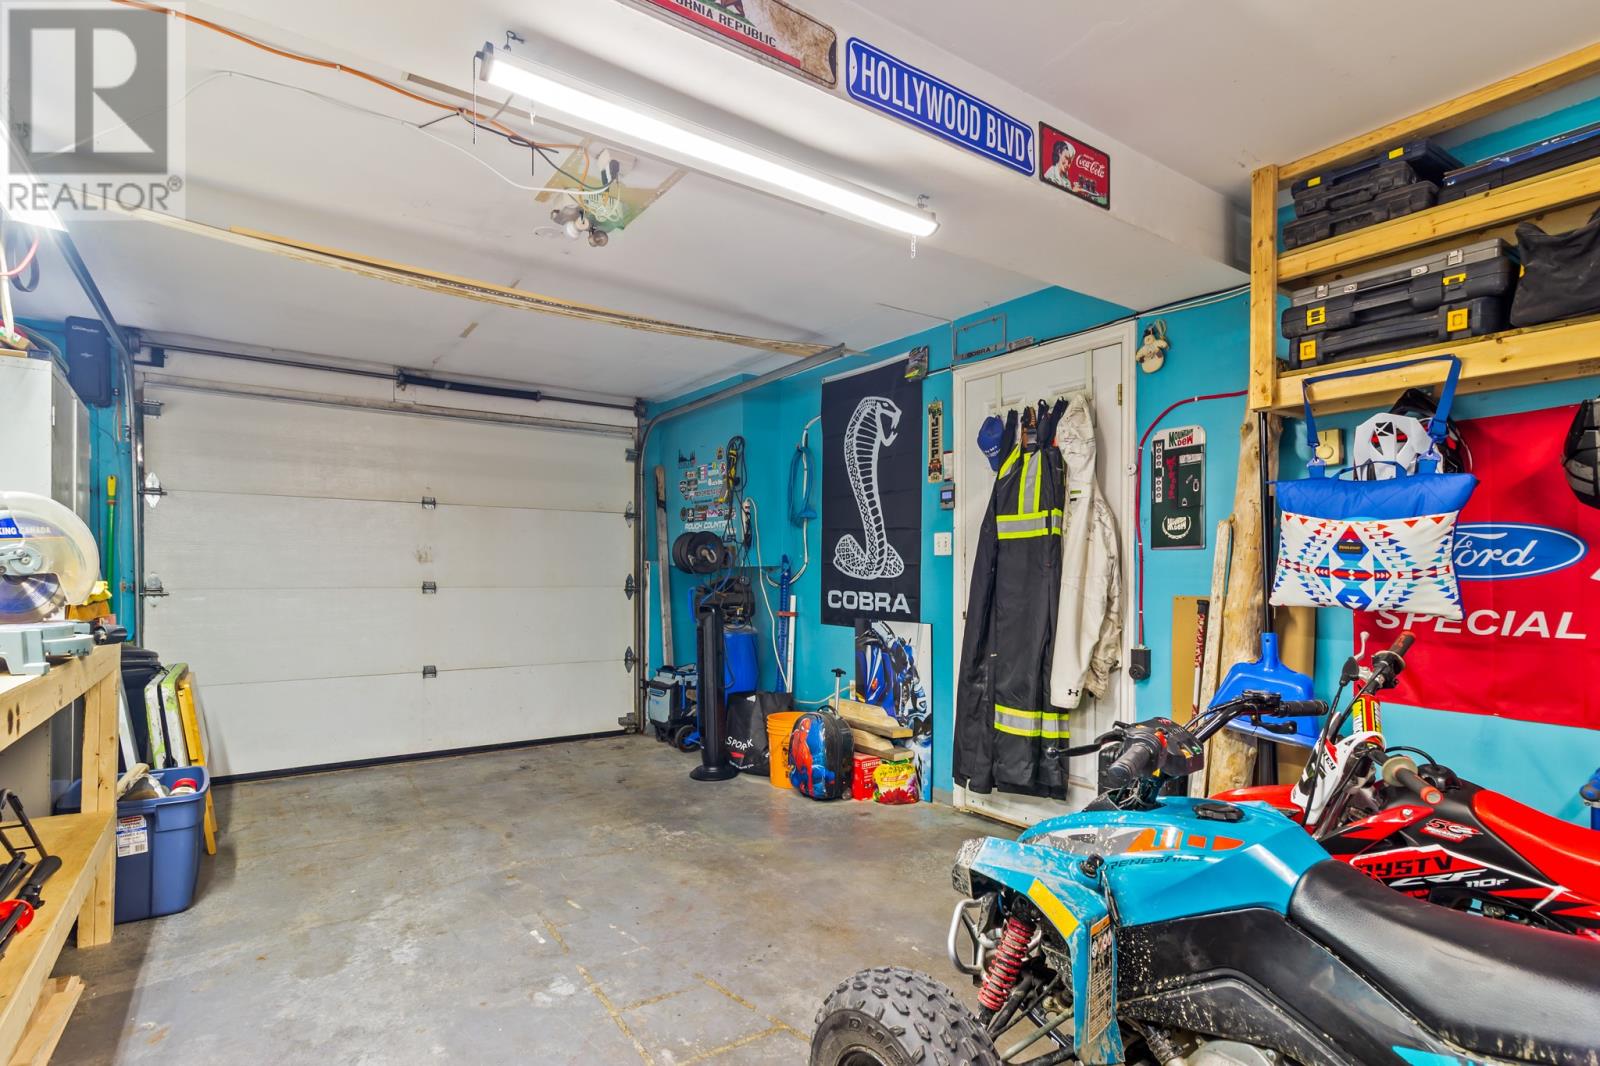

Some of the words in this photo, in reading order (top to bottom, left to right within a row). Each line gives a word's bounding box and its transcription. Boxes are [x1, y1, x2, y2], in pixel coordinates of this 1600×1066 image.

[718, 12, 777, 48] REPUBLIC
[861, 52, 981, 141] HOLLYWOOD
[986, 112, 1025, 162] BLVD
[827, 589, 911, 614] COBRA
[726, 736, 754, 751] SPORK
